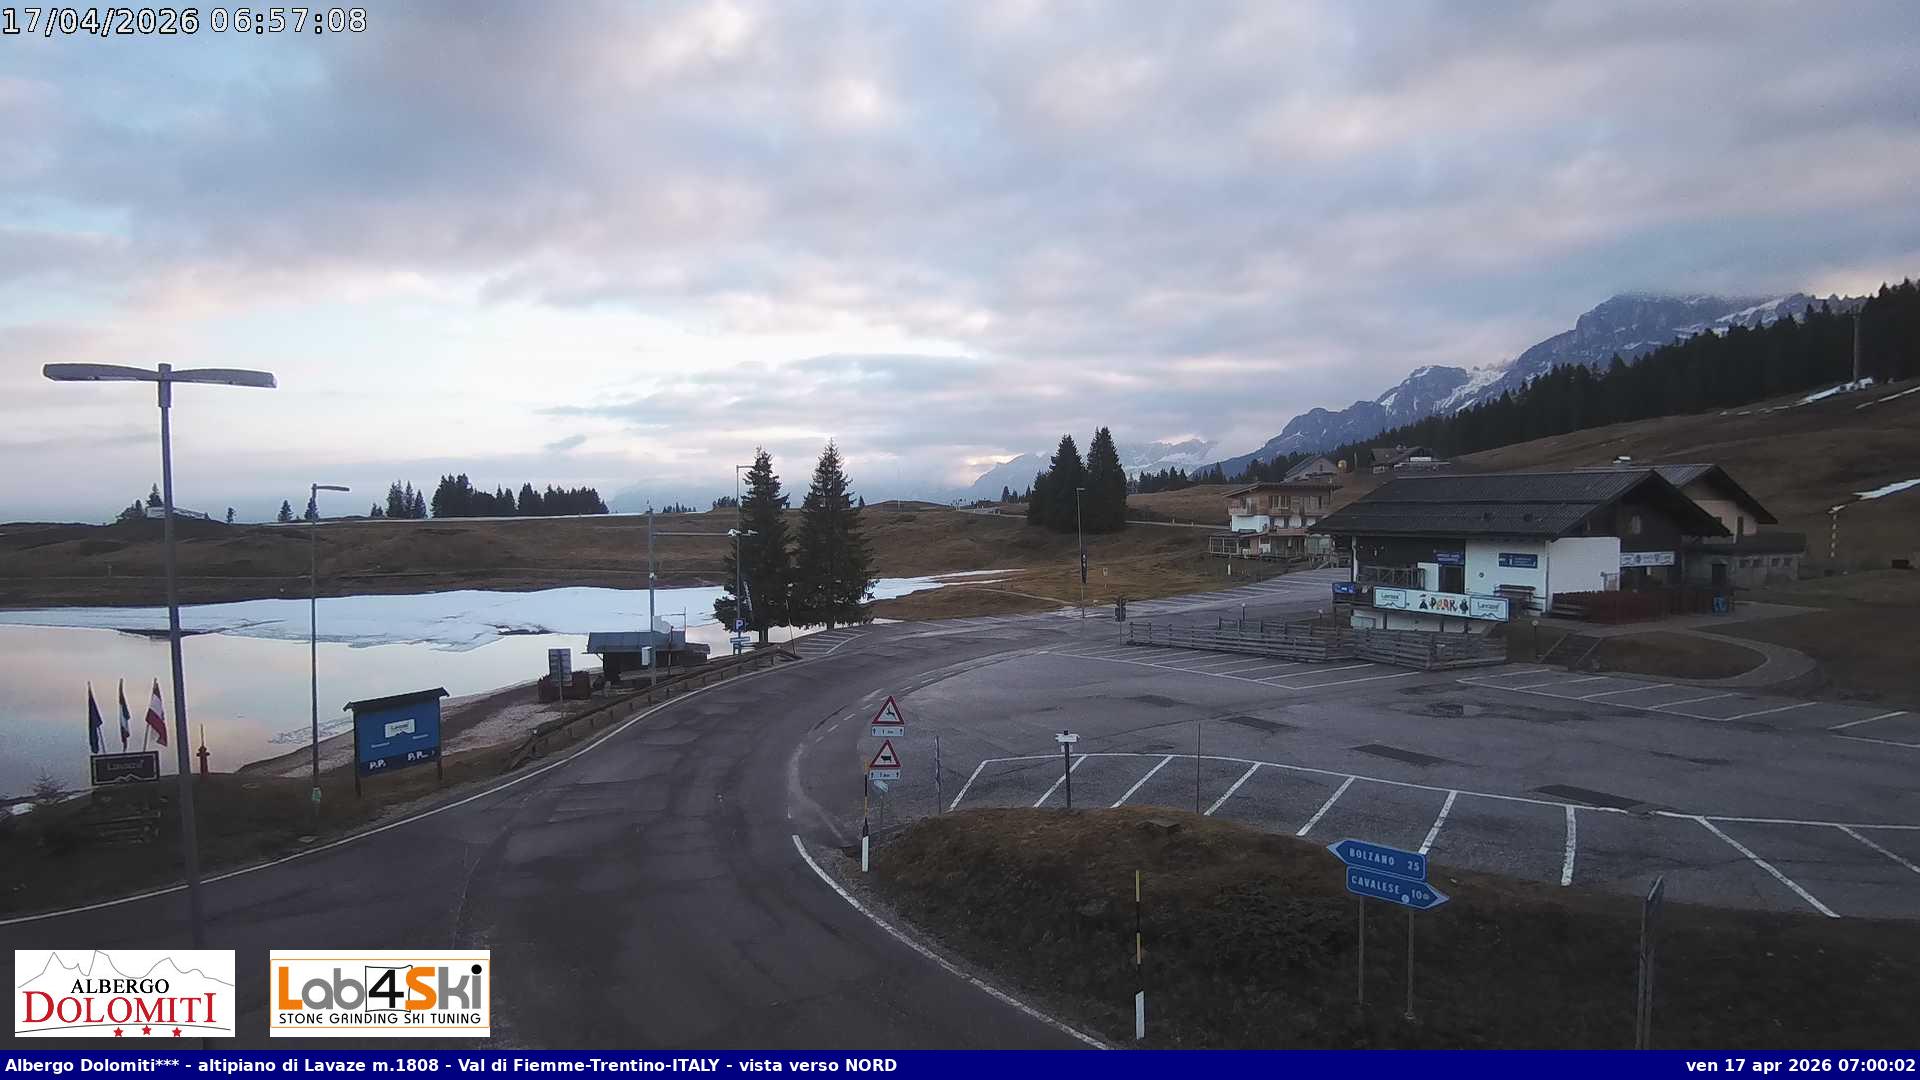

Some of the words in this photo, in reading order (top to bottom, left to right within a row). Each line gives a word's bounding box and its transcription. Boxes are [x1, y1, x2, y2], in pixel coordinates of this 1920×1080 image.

[735, 619, 744, 630] P
[1349, 847, 1395, 866] BOLZANO
[1407, 860, 1420, 872] 25
[1351, 875, 1401, 895] CAVALESE
